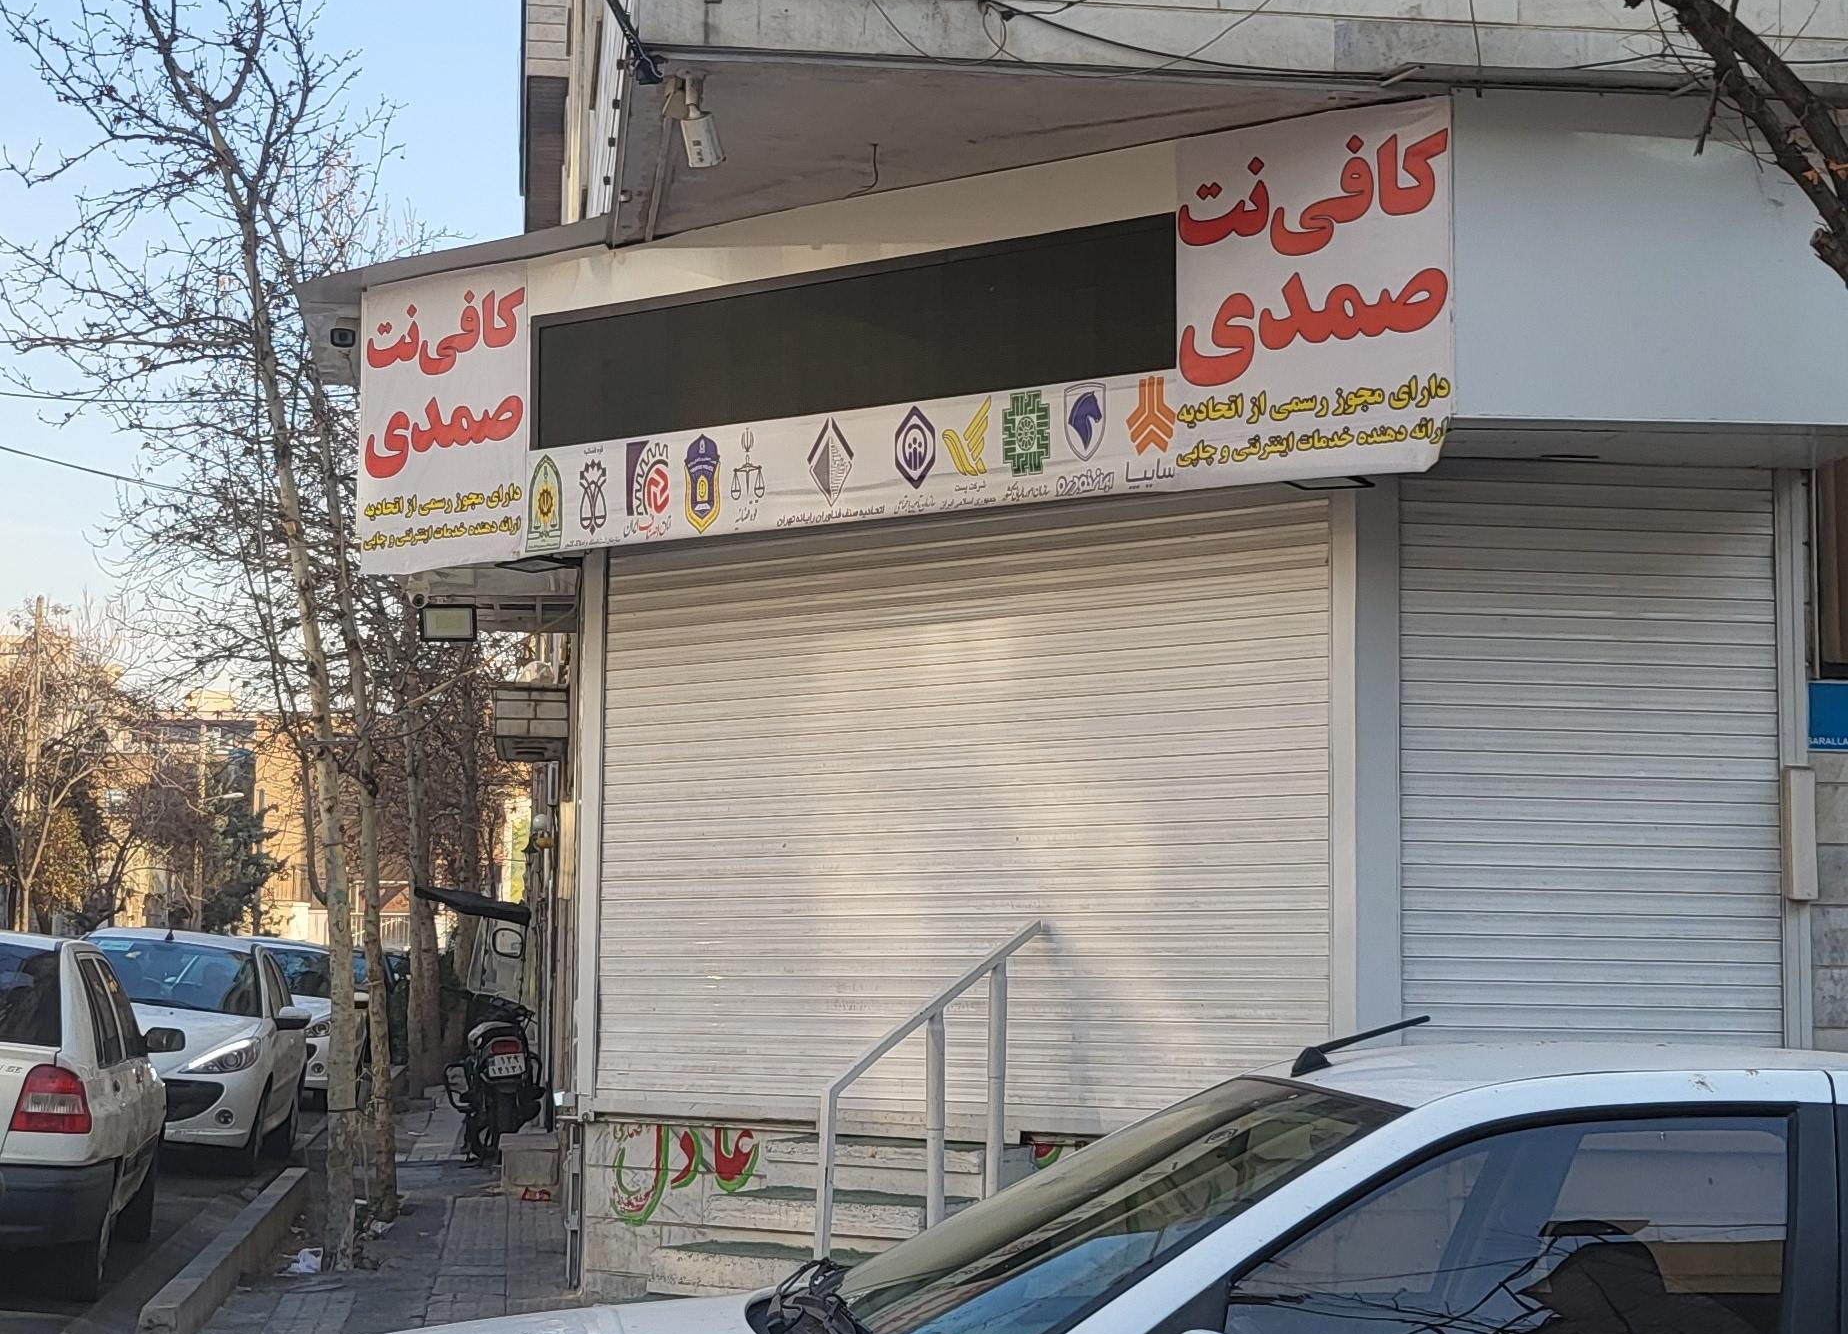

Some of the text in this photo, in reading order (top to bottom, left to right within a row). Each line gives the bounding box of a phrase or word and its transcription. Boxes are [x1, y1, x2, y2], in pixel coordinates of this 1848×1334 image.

[1179, 267, 1449, 387] صمدی
[1177, 373, 1451, 429] دارای مجوز رسمی از اتحادیه
[365, 395, 524, 479] صمدی
[1176, 416, 1450, 469] ارائه دهنده خدمات اینترنتی و چاپی
[1125, 458, 1175, 489] سایپا
[364, 483, 522, 522] دارای مجوز رسمی از اتحادیه
[776, 504, 885, 527] اتحادیه صنف فناوران رایانه تهران
[363, 515, 522, 551] ارائه دهنده خدمات اینترنتی و چاپی
[610, 1124, 760, 1227] عادل
